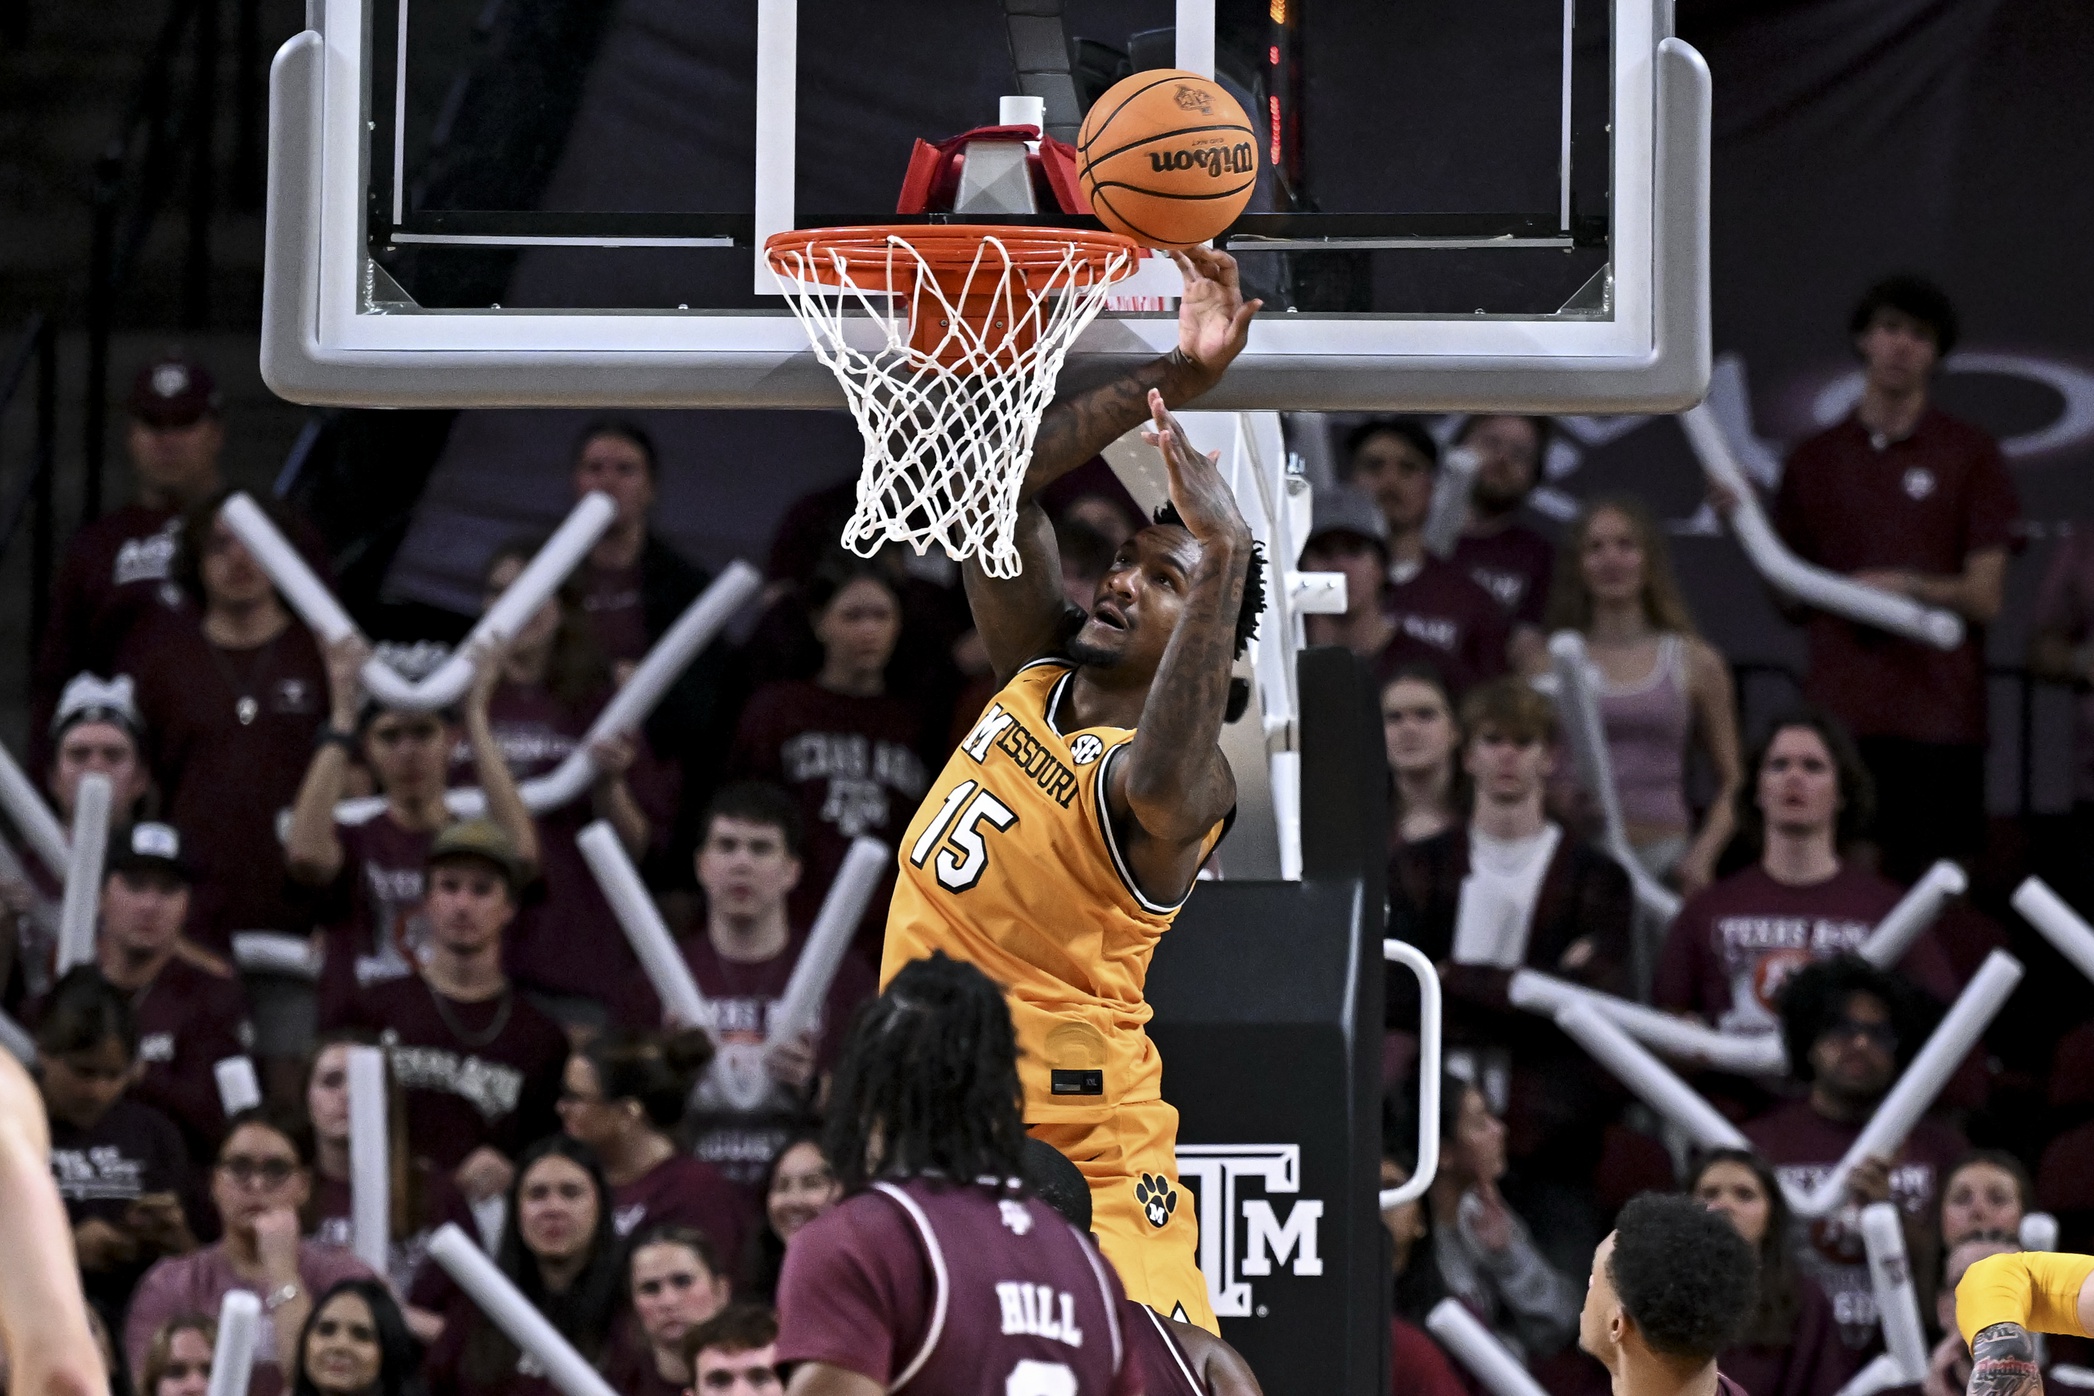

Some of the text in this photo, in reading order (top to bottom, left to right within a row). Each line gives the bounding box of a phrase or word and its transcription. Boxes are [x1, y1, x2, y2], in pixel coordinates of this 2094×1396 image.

[1146, 141, 1253, 178] Wilson
[961, 702, 1079, 809] MISSOURI
[1071, 735, 1103, 764] SEC
[910, 779, 1019, 894] 15
[1150, 1202, 1165, 1225] M
[995, 1281, 1084, 1349] HILL
